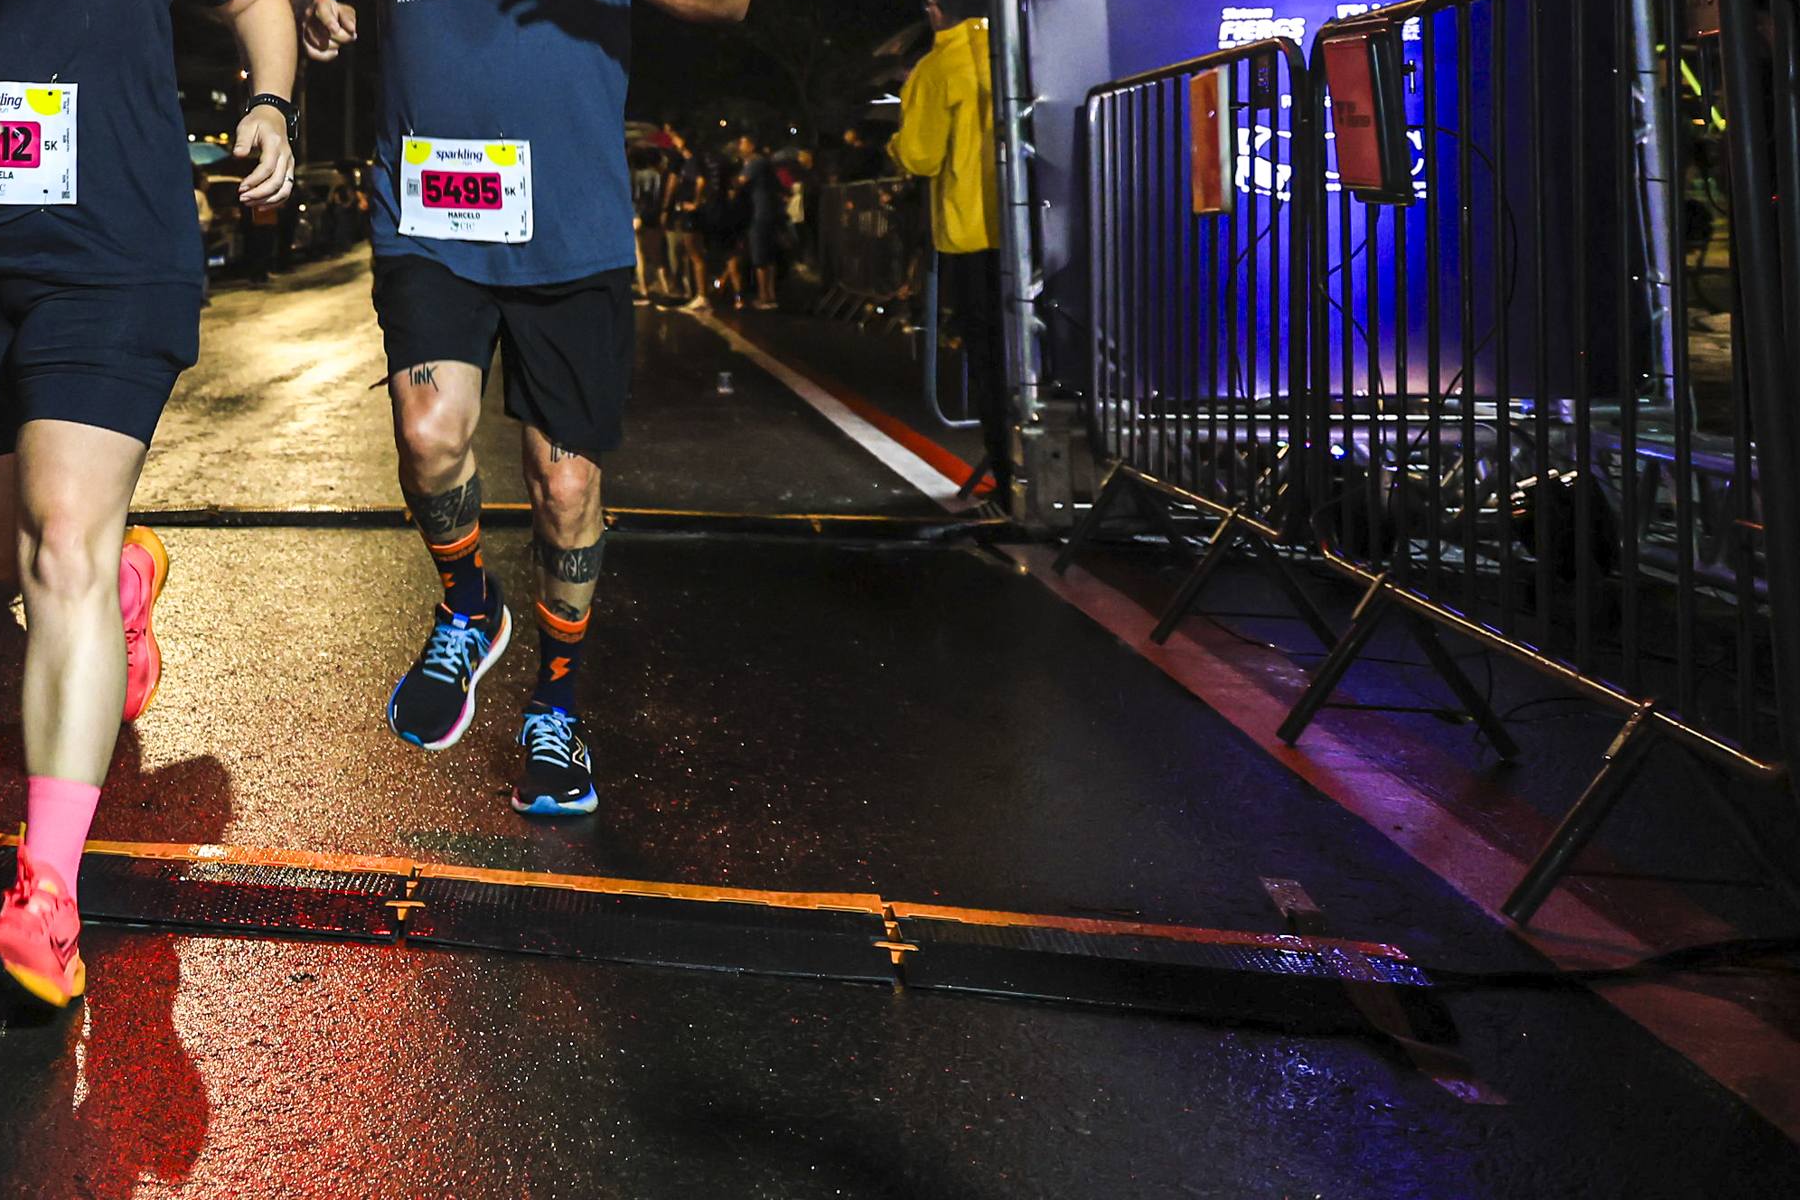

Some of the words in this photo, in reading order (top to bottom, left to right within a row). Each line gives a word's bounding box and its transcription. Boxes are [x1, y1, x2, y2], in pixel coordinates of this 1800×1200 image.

[44, 141, 58, 151] 5K
[436, 148, 483, 163] sparkling
[424, 175, 499, 205] 5495
[448, 211, 481, 220] MARCELO
